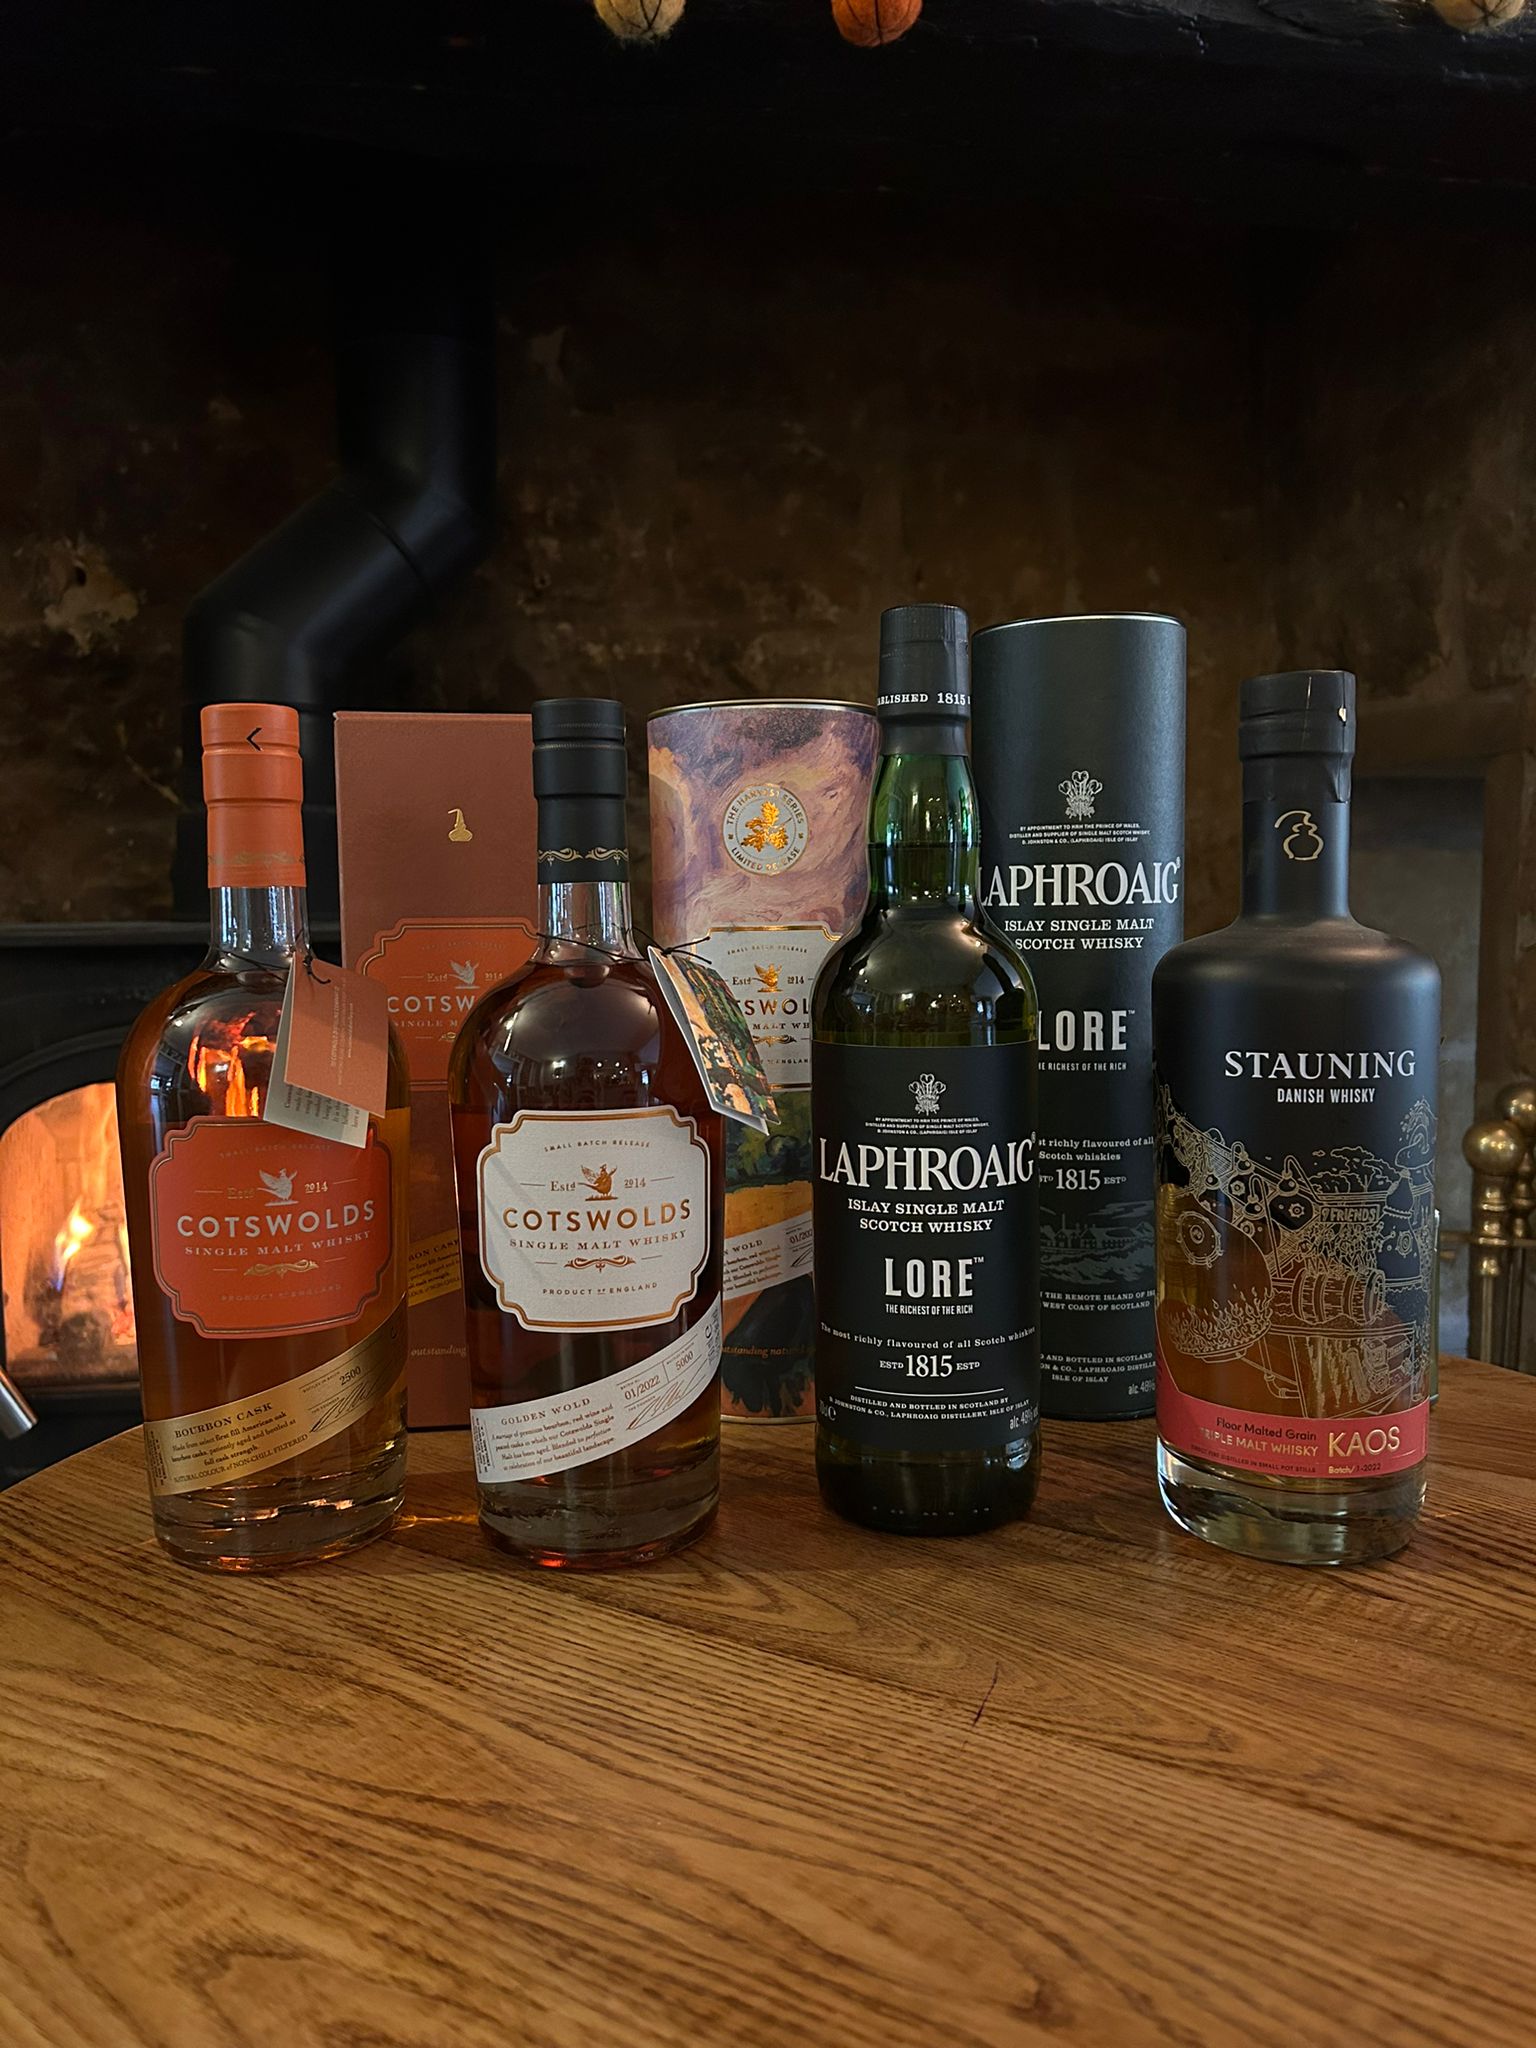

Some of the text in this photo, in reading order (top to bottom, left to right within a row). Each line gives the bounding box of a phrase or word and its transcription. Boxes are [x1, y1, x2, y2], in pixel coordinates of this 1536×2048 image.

[937, 692, 966, 706] 1815
[727, 806, 739, 825] THE
[782, 794, 804, 824] SERIES
[731, 847, 763, 870] LIMITED
[1004, 918, 1155, 932] ISLAY SINGLE MALT
[1015, 936, 1144, 951] SCOTCH WHISKY
[1048, 1062, 1080, 1071] RICHEST
[1082, 1062, 1092, 1071] OF
[1094, 1062, 1107, 1071] THE
[1110, 1061, 1127, 1071] RICH
[1224, 1049, 1417, 1080] STAUNING
[1276, 1087, 1377, 1105] DANISH WHISKY
[544, 1139, 651, 1154] SMALL BATCH RELEASE
[1048, 1136, 1154, 1149] richly flavoured of all
[1039, 1150, 1121, 1162] Scotch whiskies
[304, 1180, 329, 1194] 2014
[624, 1178, 647, 1190] 2014
[1054, 1168, 1127, 1191] 1815 ESTD
[502, 1198, 692, 1233] COTSWOLDS
[848, 1198, 1006, 1216] ISLAY SINGLE MALT
[1330, 1206, 1377, 1223] FRIENDS
[176, 1200, 376, 1239] COTSWOLDS
[860, 1218, 994, 1234] SCOTCH WHISKY
[184, 1230, 372, 1257] SINGLE MALT WHISKY
[510, 1230, 688, 1251] SINGLE MALT WHISKY
[732, 1240, 764, 1252] WOLD
[542, 1282, 659, 1296] PRODUCT ENGLAND
[1045, 1290, 1145, 1301] THE REMOTE ISLAND OF
[885, 1304, 974, 1316] THE RICHEST OF THE RICH
[1042, 1300, 1151, 1311] WEST COAST OF SCOTLAND
[821, 1322, 1007, 1351] The most richly flavoured of all Scotch
[410, 1345, 468, 1361] outstanding
[675, 1350, 695, 1372] 5000
[1046, 1354, 1064, 1363] AND
[1065, 1356, 1104, 1364] BOTTLED
[1104, 1356, 1115, 1364] IN
[1116, 1352, 1153, 1363] SCOTLAND
[879, 1354, 981, 1378] ESTD 1815 ESTD
[1078, 1365, 1126, 1374] LAPHROAIG
[339, 1366, 362, 1386] 2500
[1052, 1374, 1109, 1383] ISLE OF ISLAY
[624, 1374, 661, 1401] 01/2022
[850, 1394, 1009, 1411] DISTILLED AND BOTTLED IN SCOTLAND BY
[174, 1402, 274, 1439] BOURBON CASK
[500, 1398, 591, 1427] GOLDEN WOLD
[890, 1410, 940, 1421] LAPHROAIG
[990, 1407, 1005, 1417] ISLE
[1005, 1404, 1015, 1413] OF
[1216, 1417, 1317, 1442] Floor Malted Grain
[272, 1433, 309, 1455] FILTERED
[1236, 1436, 1268, 1453] MALT
[1270, 1444, 1319, 1458] WHISKY
[1328, 1426, 1401, 1458] KAOS
